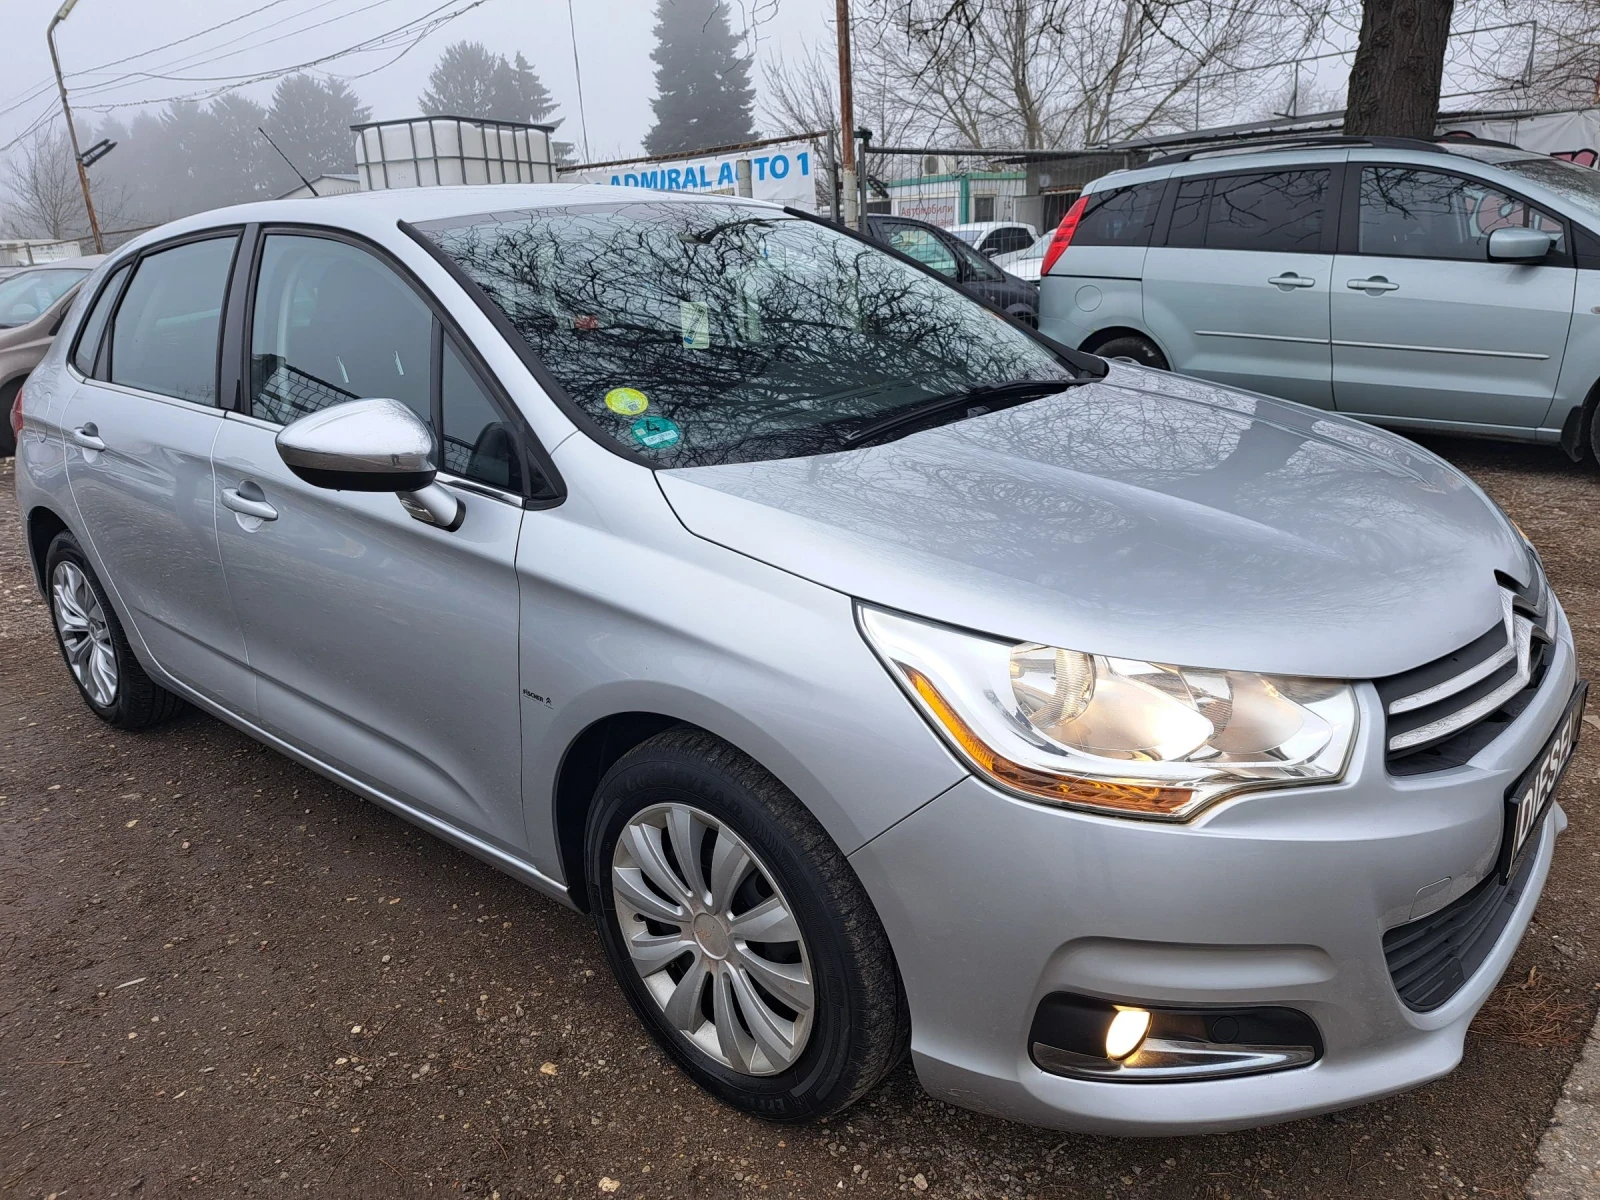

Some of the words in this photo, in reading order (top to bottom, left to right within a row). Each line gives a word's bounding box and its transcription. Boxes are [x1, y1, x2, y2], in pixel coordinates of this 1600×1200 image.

[797, 152, 809, 176] 1
[901, 203, 953, 216] Автомобили
[1517, 711, 1573, 852] DIESEL
